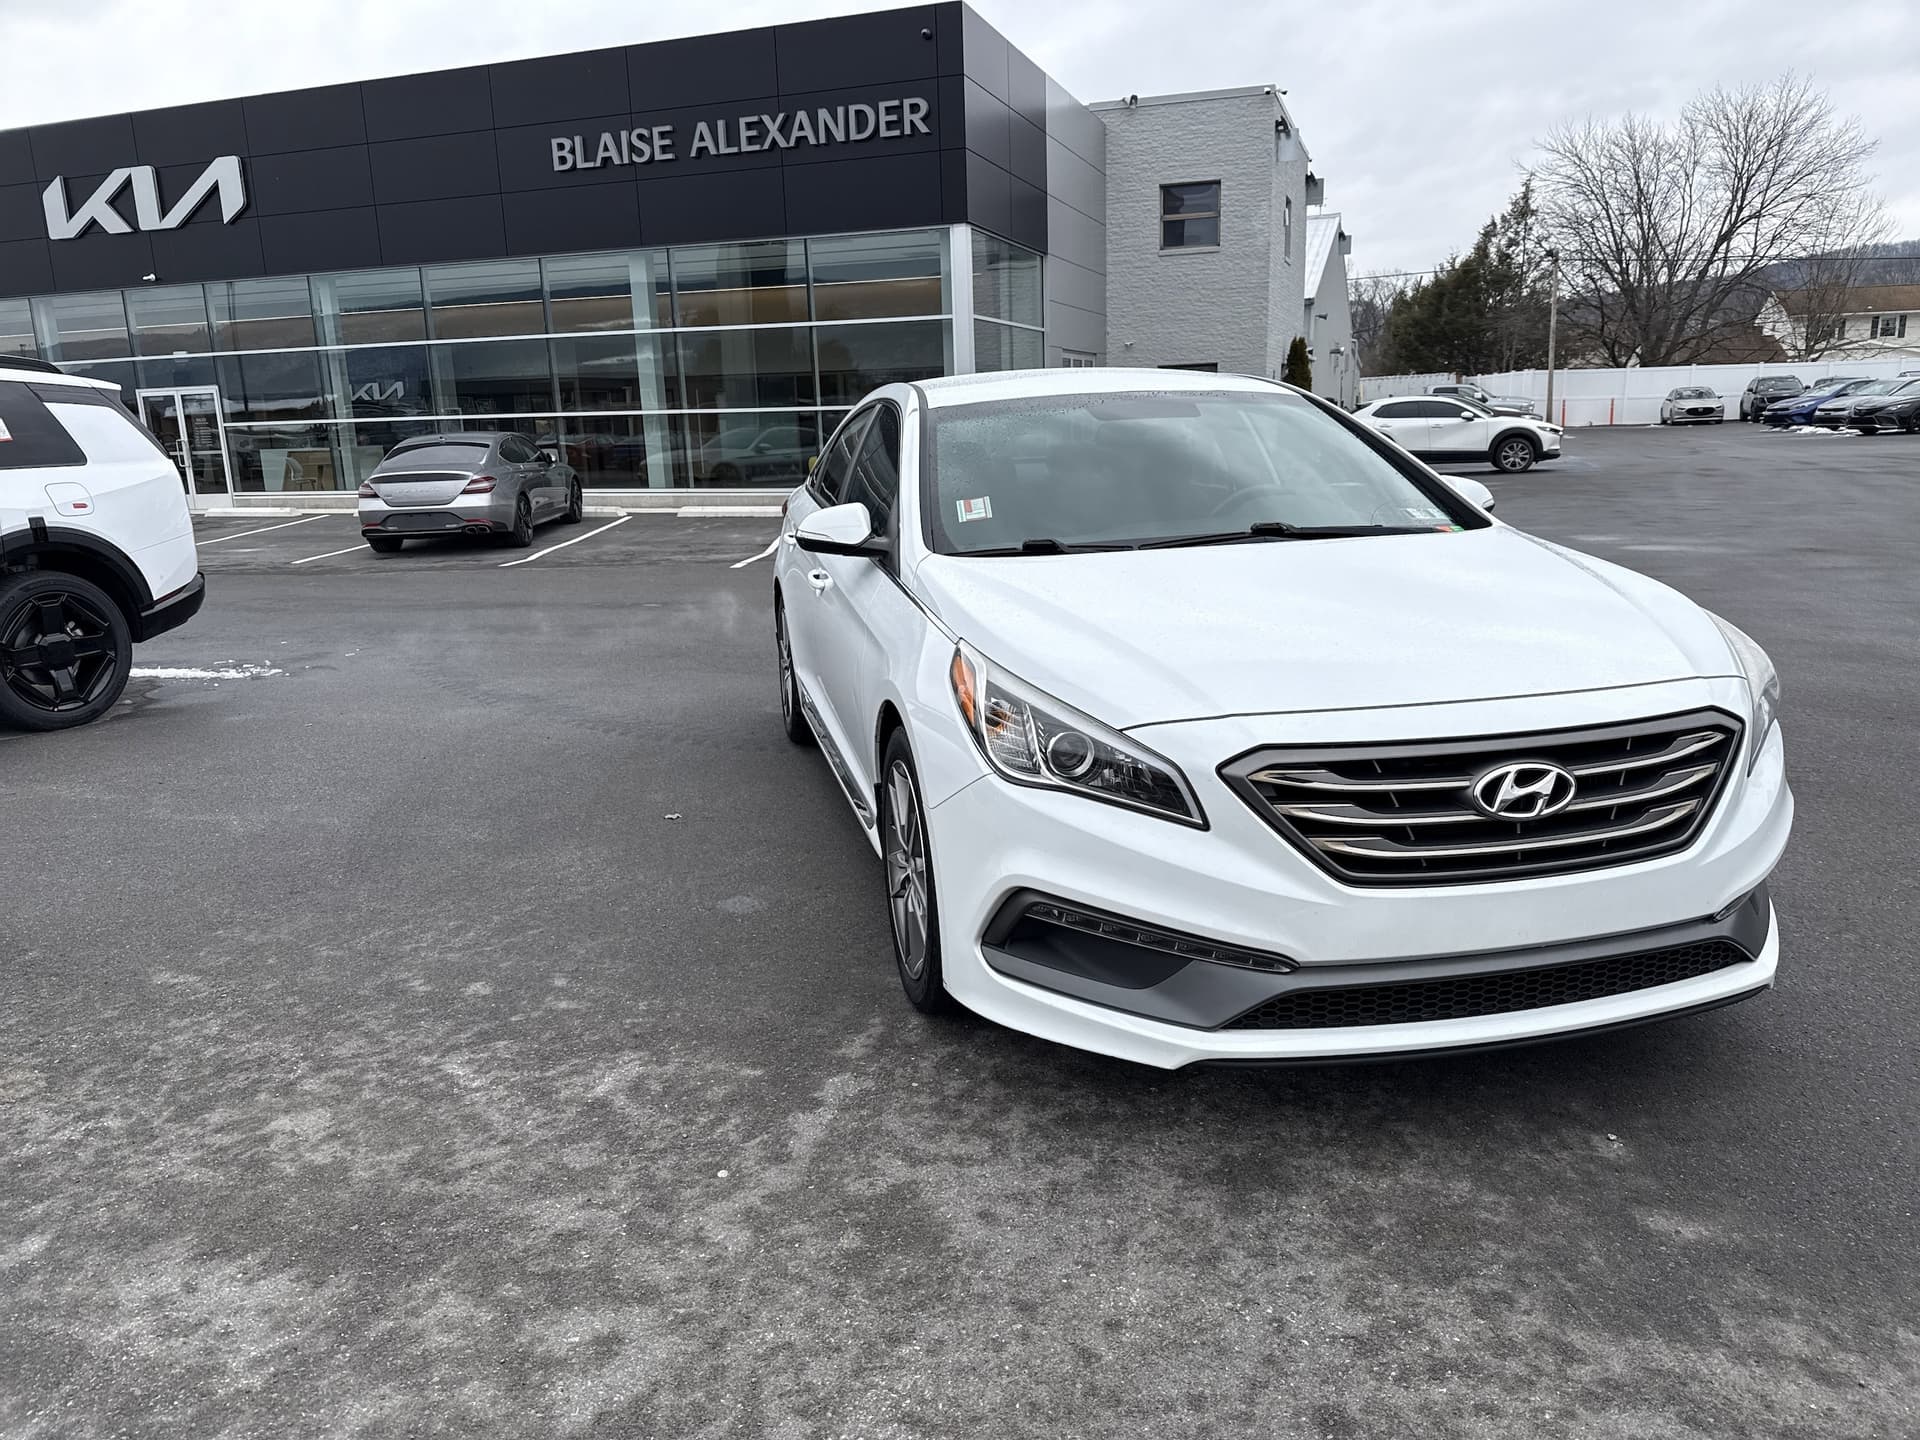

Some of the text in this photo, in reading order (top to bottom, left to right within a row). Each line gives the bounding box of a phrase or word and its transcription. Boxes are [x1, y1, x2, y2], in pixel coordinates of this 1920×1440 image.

[550, 97, 931, 172] BLAISE ALEXANDER
[42, 155, 247, 240] KIA
